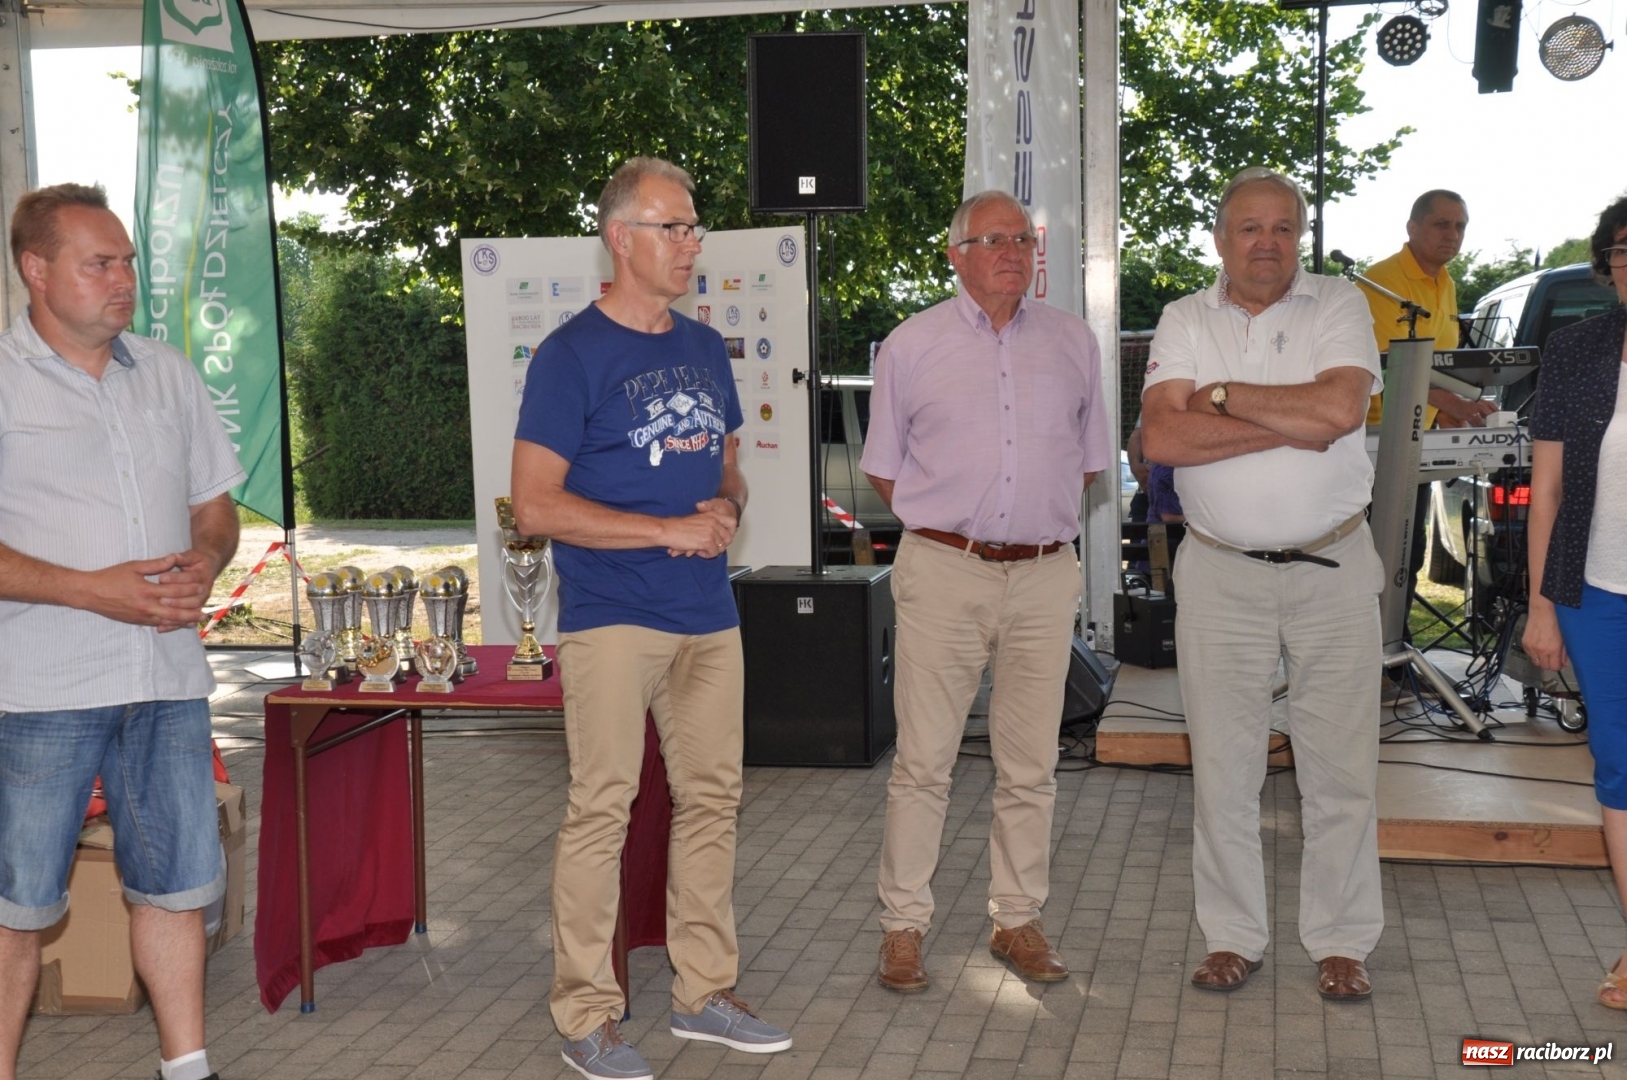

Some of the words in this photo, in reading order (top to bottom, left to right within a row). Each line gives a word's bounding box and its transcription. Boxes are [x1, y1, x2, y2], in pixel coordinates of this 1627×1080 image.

[1433, 353, 1454, 367] RG
[634, 414, 674, 448] GENUINE
[1411, 404, 1423, 441] PRO
[756, 440, 778, 449] Auchan
